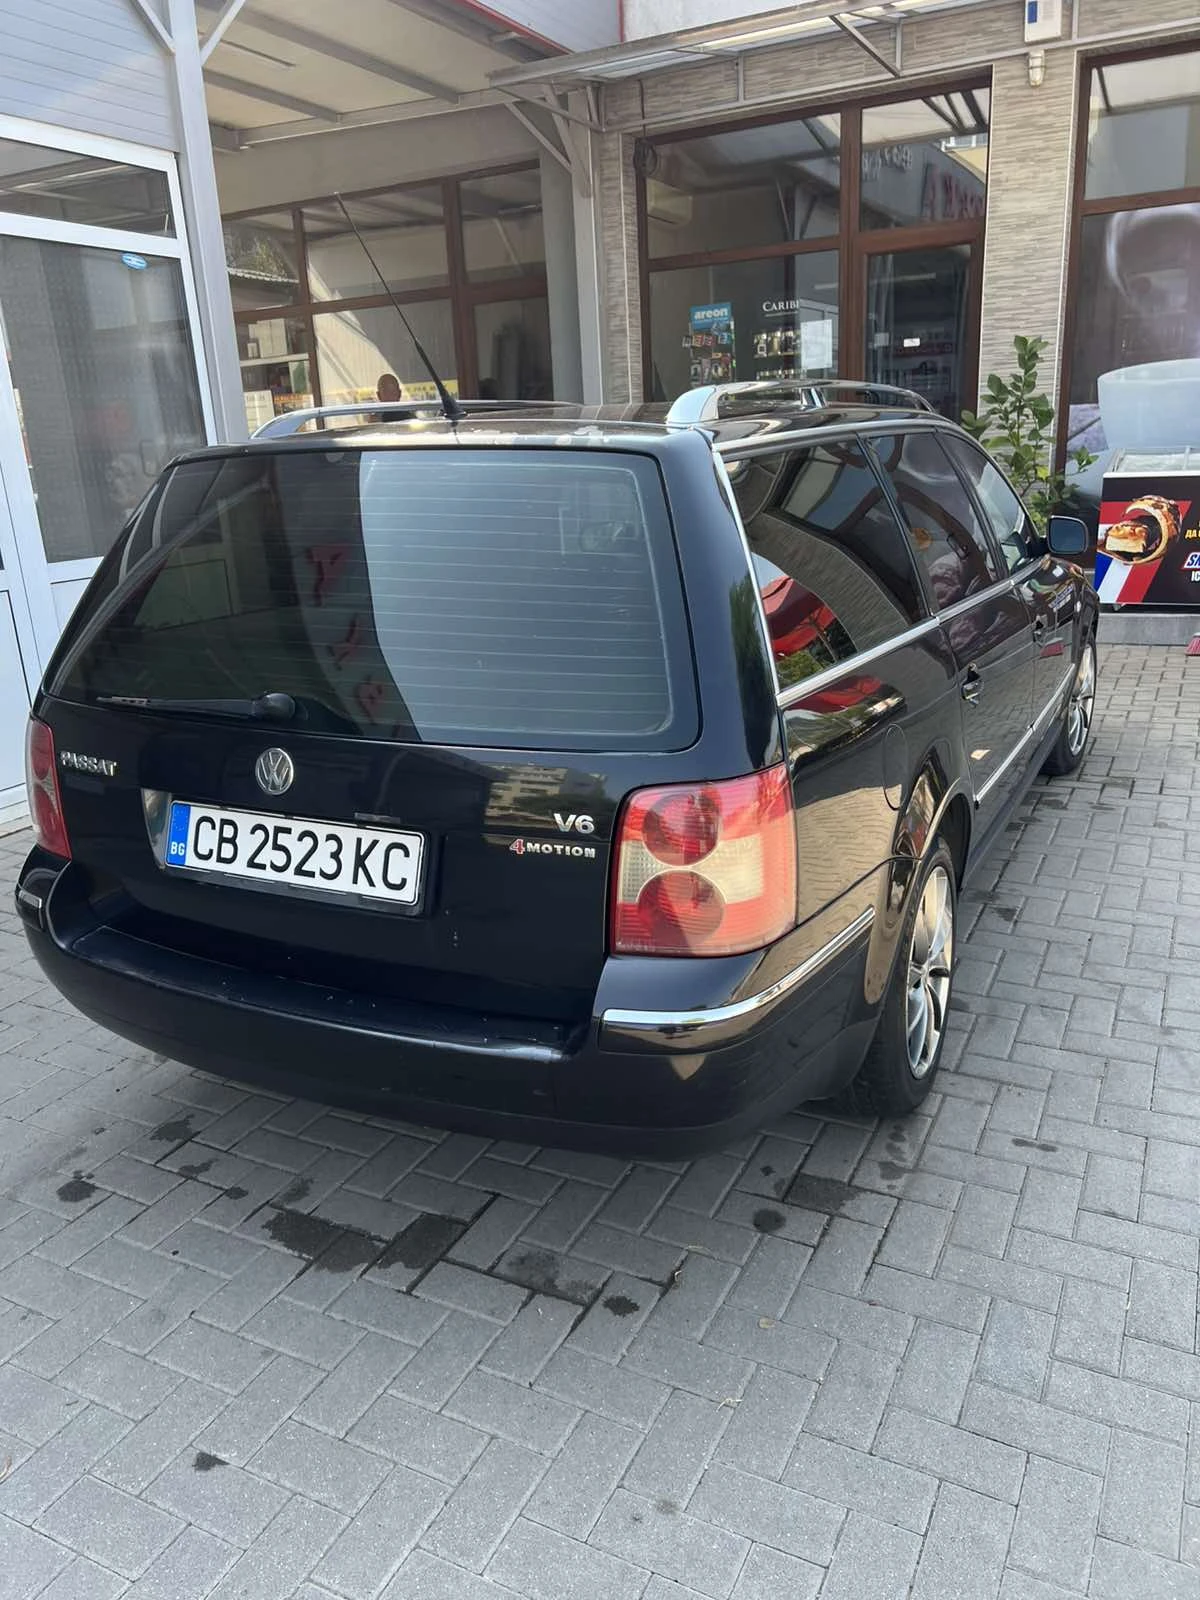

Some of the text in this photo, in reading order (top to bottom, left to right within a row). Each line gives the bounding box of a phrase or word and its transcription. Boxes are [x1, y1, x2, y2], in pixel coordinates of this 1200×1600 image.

[694, 308, 728, 320] areon
[60, 750, 118, 777] PASSAT
[553, 812, 595, 834] V6
[170, 841, 186, 856] BG
[508, 838, 596, 859] 4MOTION
